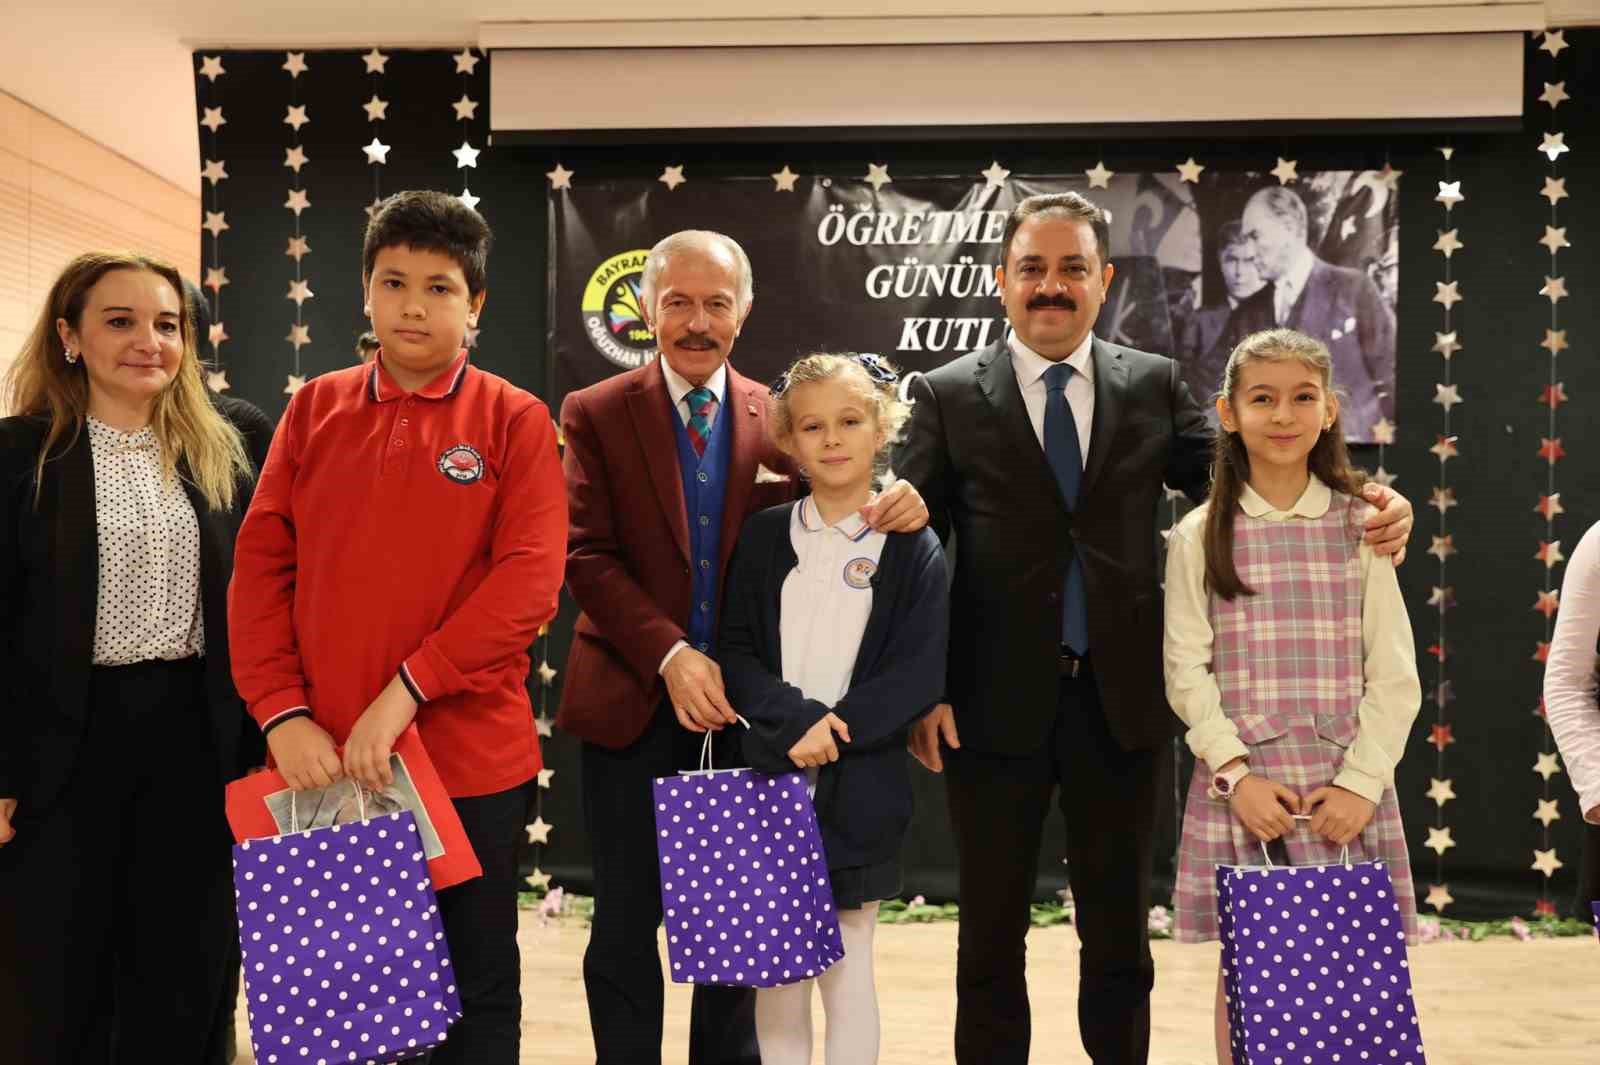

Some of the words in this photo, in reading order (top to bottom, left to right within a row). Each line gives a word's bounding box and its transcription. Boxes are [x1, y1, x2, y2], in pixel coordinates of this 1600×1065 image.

[817, 203, 1112, 246] ÖĞRETME
[865, 256, 1004, 299] GÜNÜM
[896, 317, 1011, 352] KUTL
